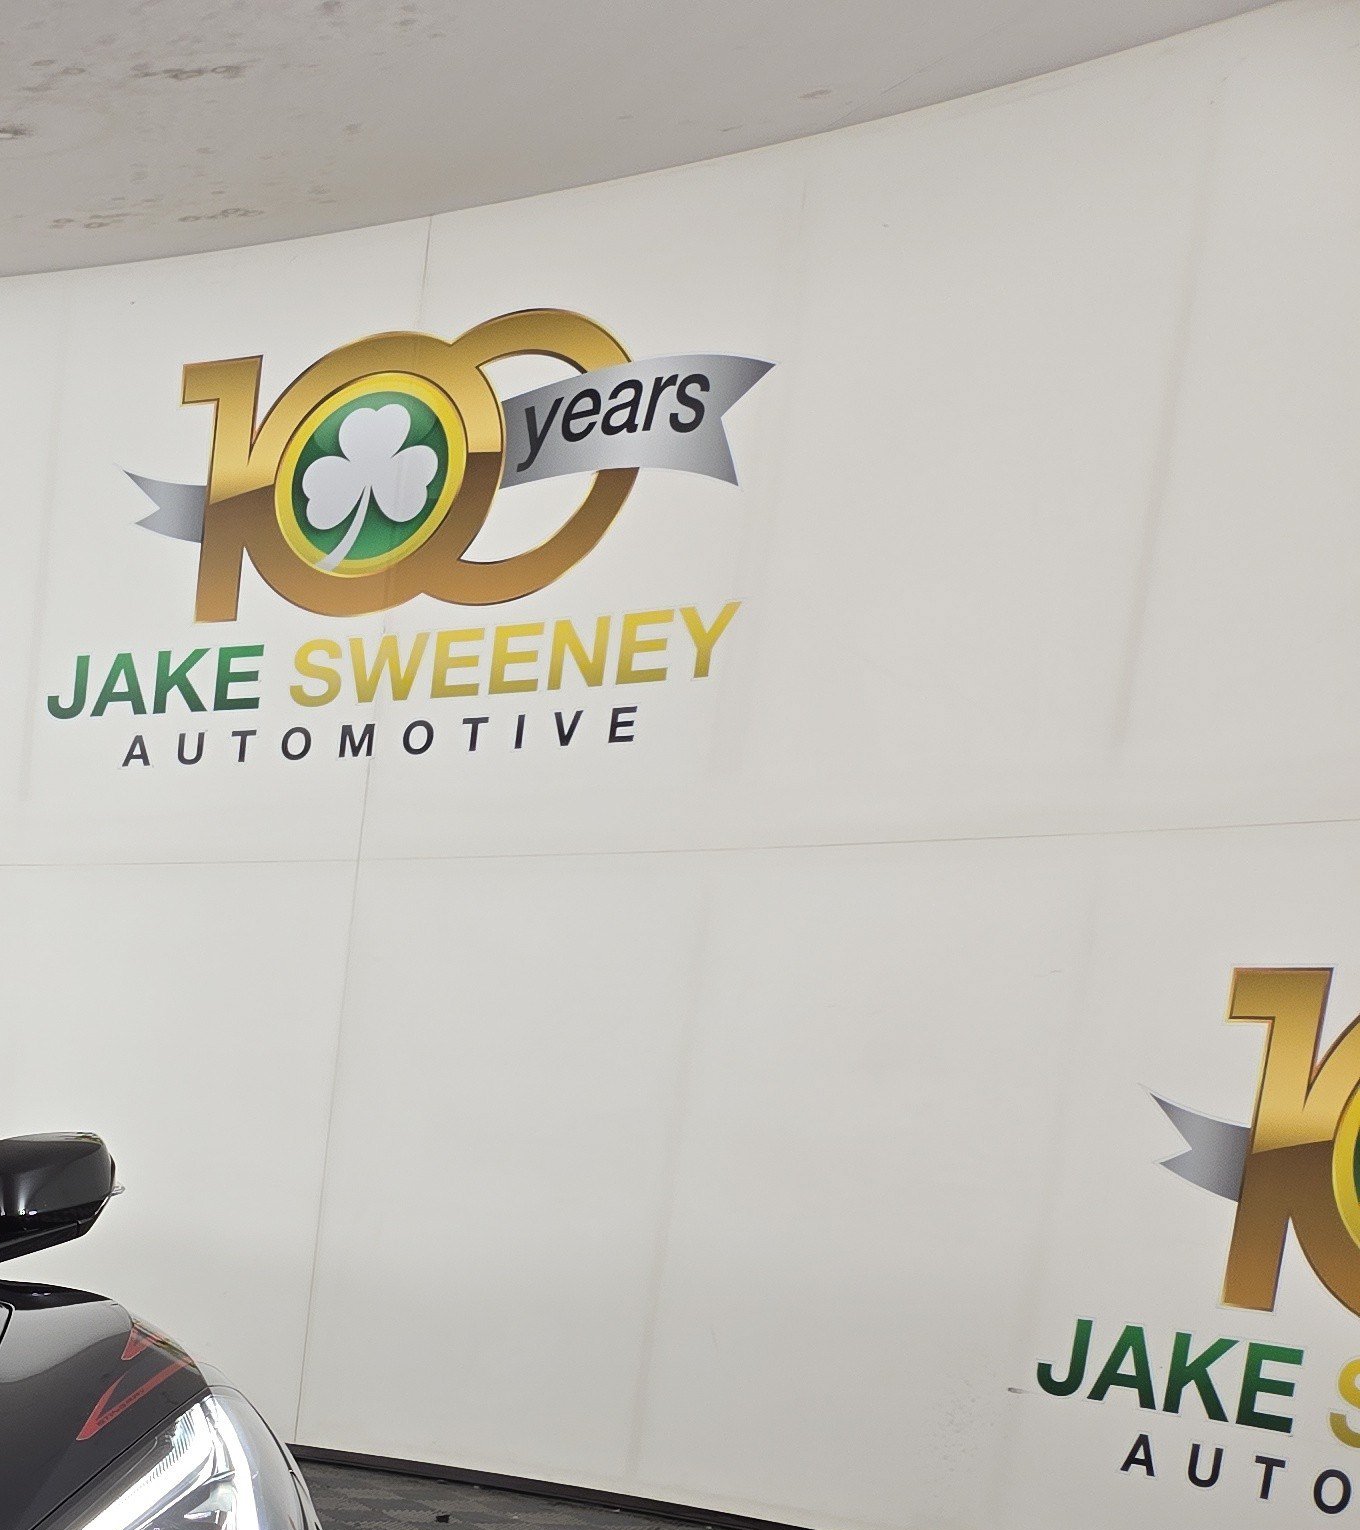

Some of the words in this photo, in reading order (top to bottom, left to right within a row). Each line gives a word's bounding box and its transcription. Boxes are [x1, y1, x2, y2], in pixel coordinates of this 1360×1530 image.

[517, 371, 711, 472] years
[47, 643, 265, 720] JAKE
[289, 600, 743, 708] SWEENEY
[122, 705, 640, 768] AUTOMOTIVE
[1036, 1318, 1305, 1434] JAKE
